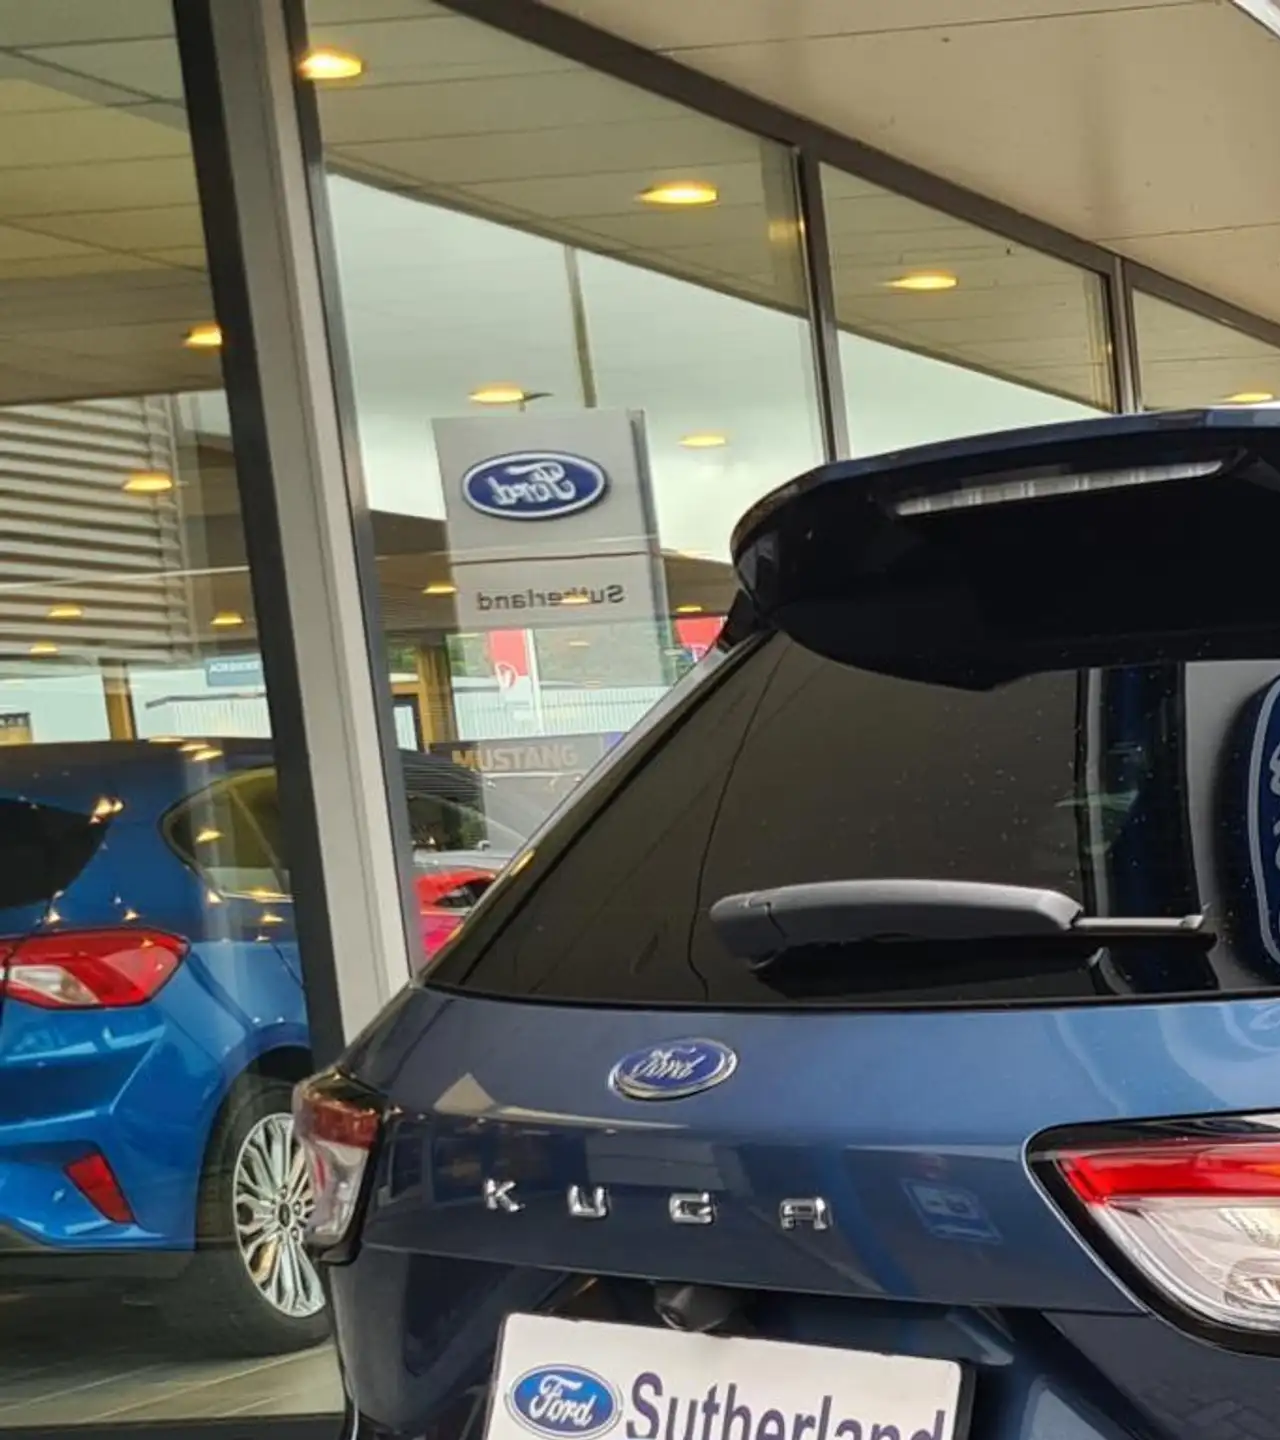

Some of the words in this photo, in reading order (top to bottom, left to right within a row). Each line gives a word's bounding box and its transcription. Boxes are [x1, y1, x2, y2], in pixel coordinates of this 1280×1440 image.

[451, 743, 580, 773] MUSTANG
[629, 1046, 705, 1080] Ford
[483, 1177, 833, 1231] KUGA
[529, 1373, 596, 1430] Ford
